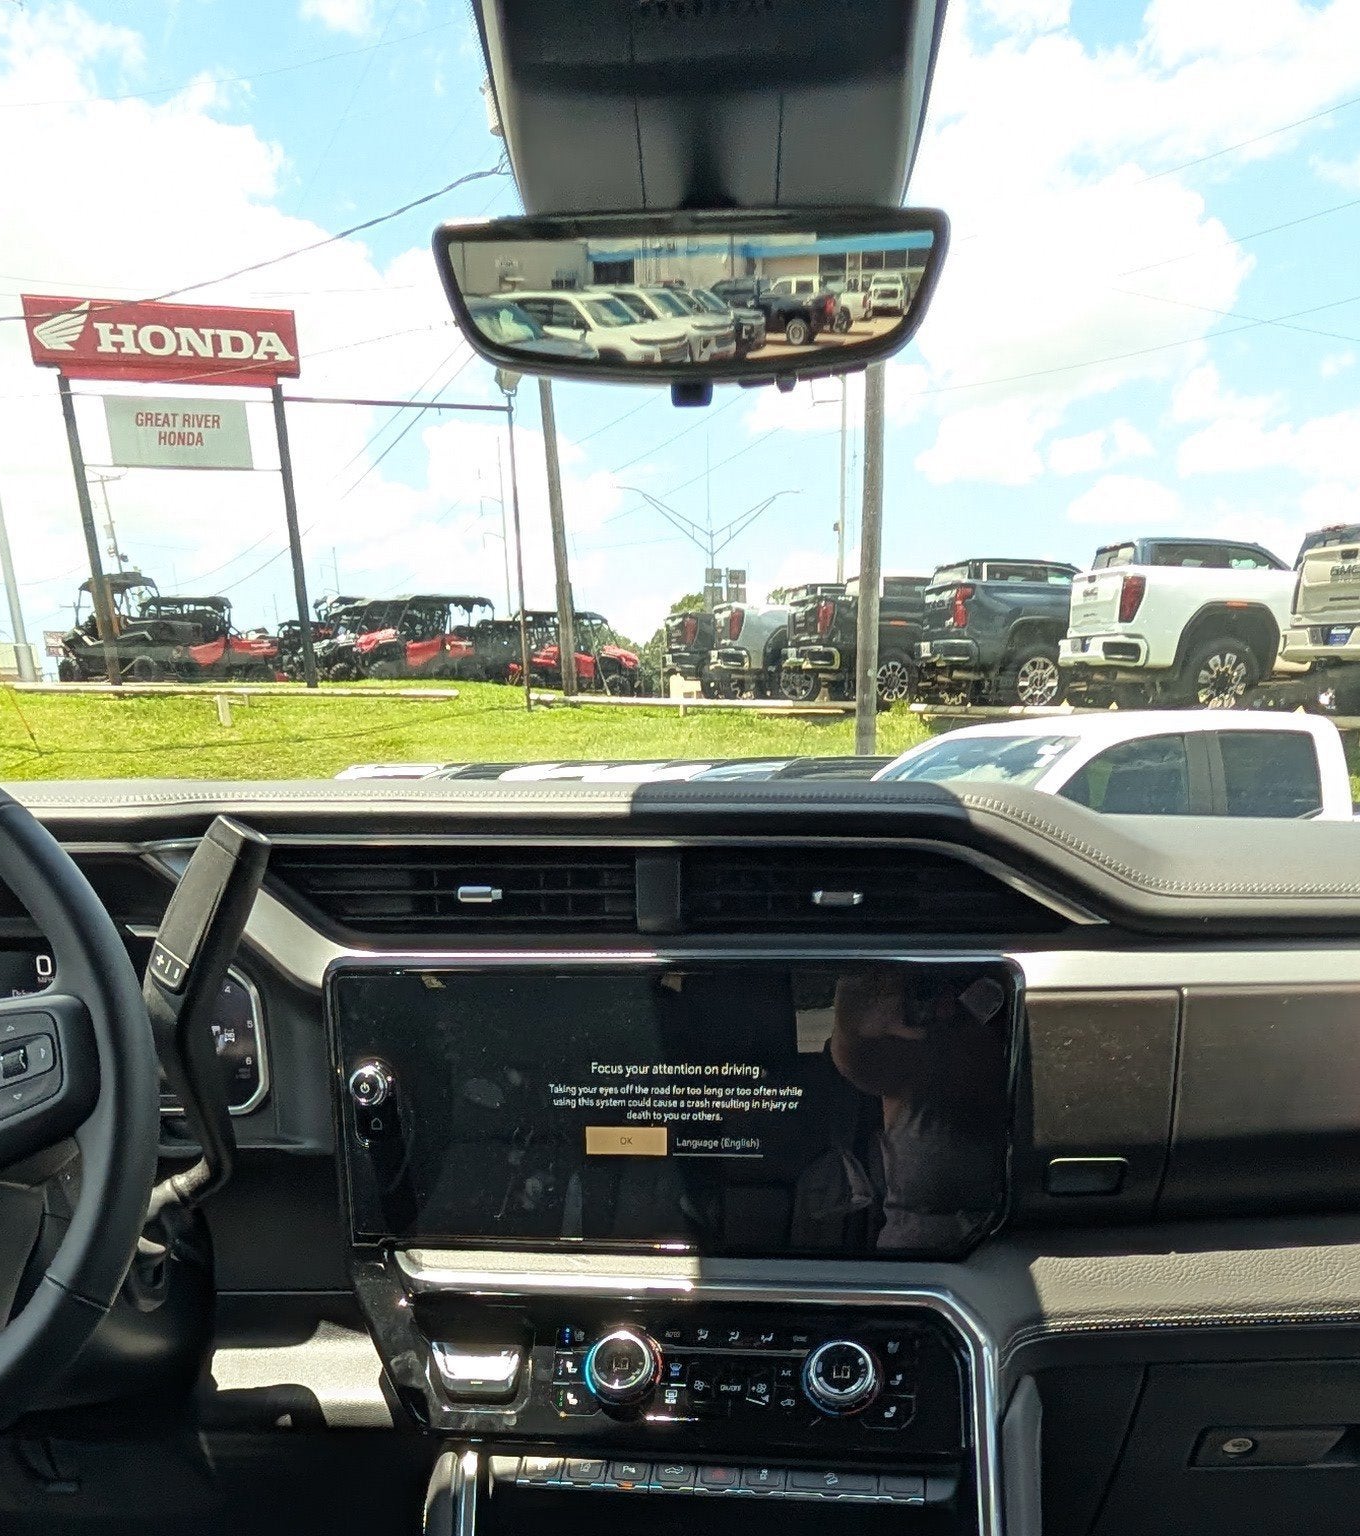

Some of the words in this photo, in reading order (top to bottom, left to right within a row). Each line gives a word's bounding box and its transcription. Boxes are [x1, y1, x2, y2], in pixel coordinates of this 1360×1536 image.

[93, 322, 295, 361] HONDA
[136, 412, 178, 428] GREAT
[182, 413, 221, 429] RIVER
[158, 431, 204, 447] HONDA
[591, 1061, 624, 1075] Focus
[625, 1064, 650, 1077] your
[652, 1062, 702, 1076] attention
[704, 1065, 719, 1076] on
[721, 1062, 760, 1078] driving
[549, 1083, 577, 1096] Taking
[578, 1086, 597, 1096] your
[599, 1086, 619, 1096] eyes
[620, 1084, 634, 1094] off
[634, 1084, 649, 1095] the
[651, 1085, 671, 1095] road
[672, 1085, 685, 1095] for
[687, 1086, 702, 1095] too
[703, 1085, 723, 1097] long
[725, 1087, 735, 1096] or
[736, 1086, 751, 1096] too
[753, 1085, 778, 1096] often
[779, 1086, 803, 1097] while
[553, 1098, 577, 1109] using
[578, 1097, 594, 1107] this
[595, 1098, 626, 1109] system
[627, 1097, 652, 1107] could
[653, 1099, 678, 1108] cause
[679, 1100, 685, 1108] a
[686, 1098, 710, 1109] crash
[712, 1098, 750, 1111] resulting
[752, 1099, 760, 1109] in
[761, 1099, 787, 1112] injury
[788, 1101, 798, 1110] or
[626, 1110, 651, 1120] death
[652, 1111, 662, 1120] to
[663, 1112, 679, 1122] you
[681, 1112, 690, 1120] or
[692, 1111, 723, 1121] others.
[619, 1136, 634, 1146] OK
[676, 1137, 719, 1149] Language
[720, 1137, 760, 1150] (English)
